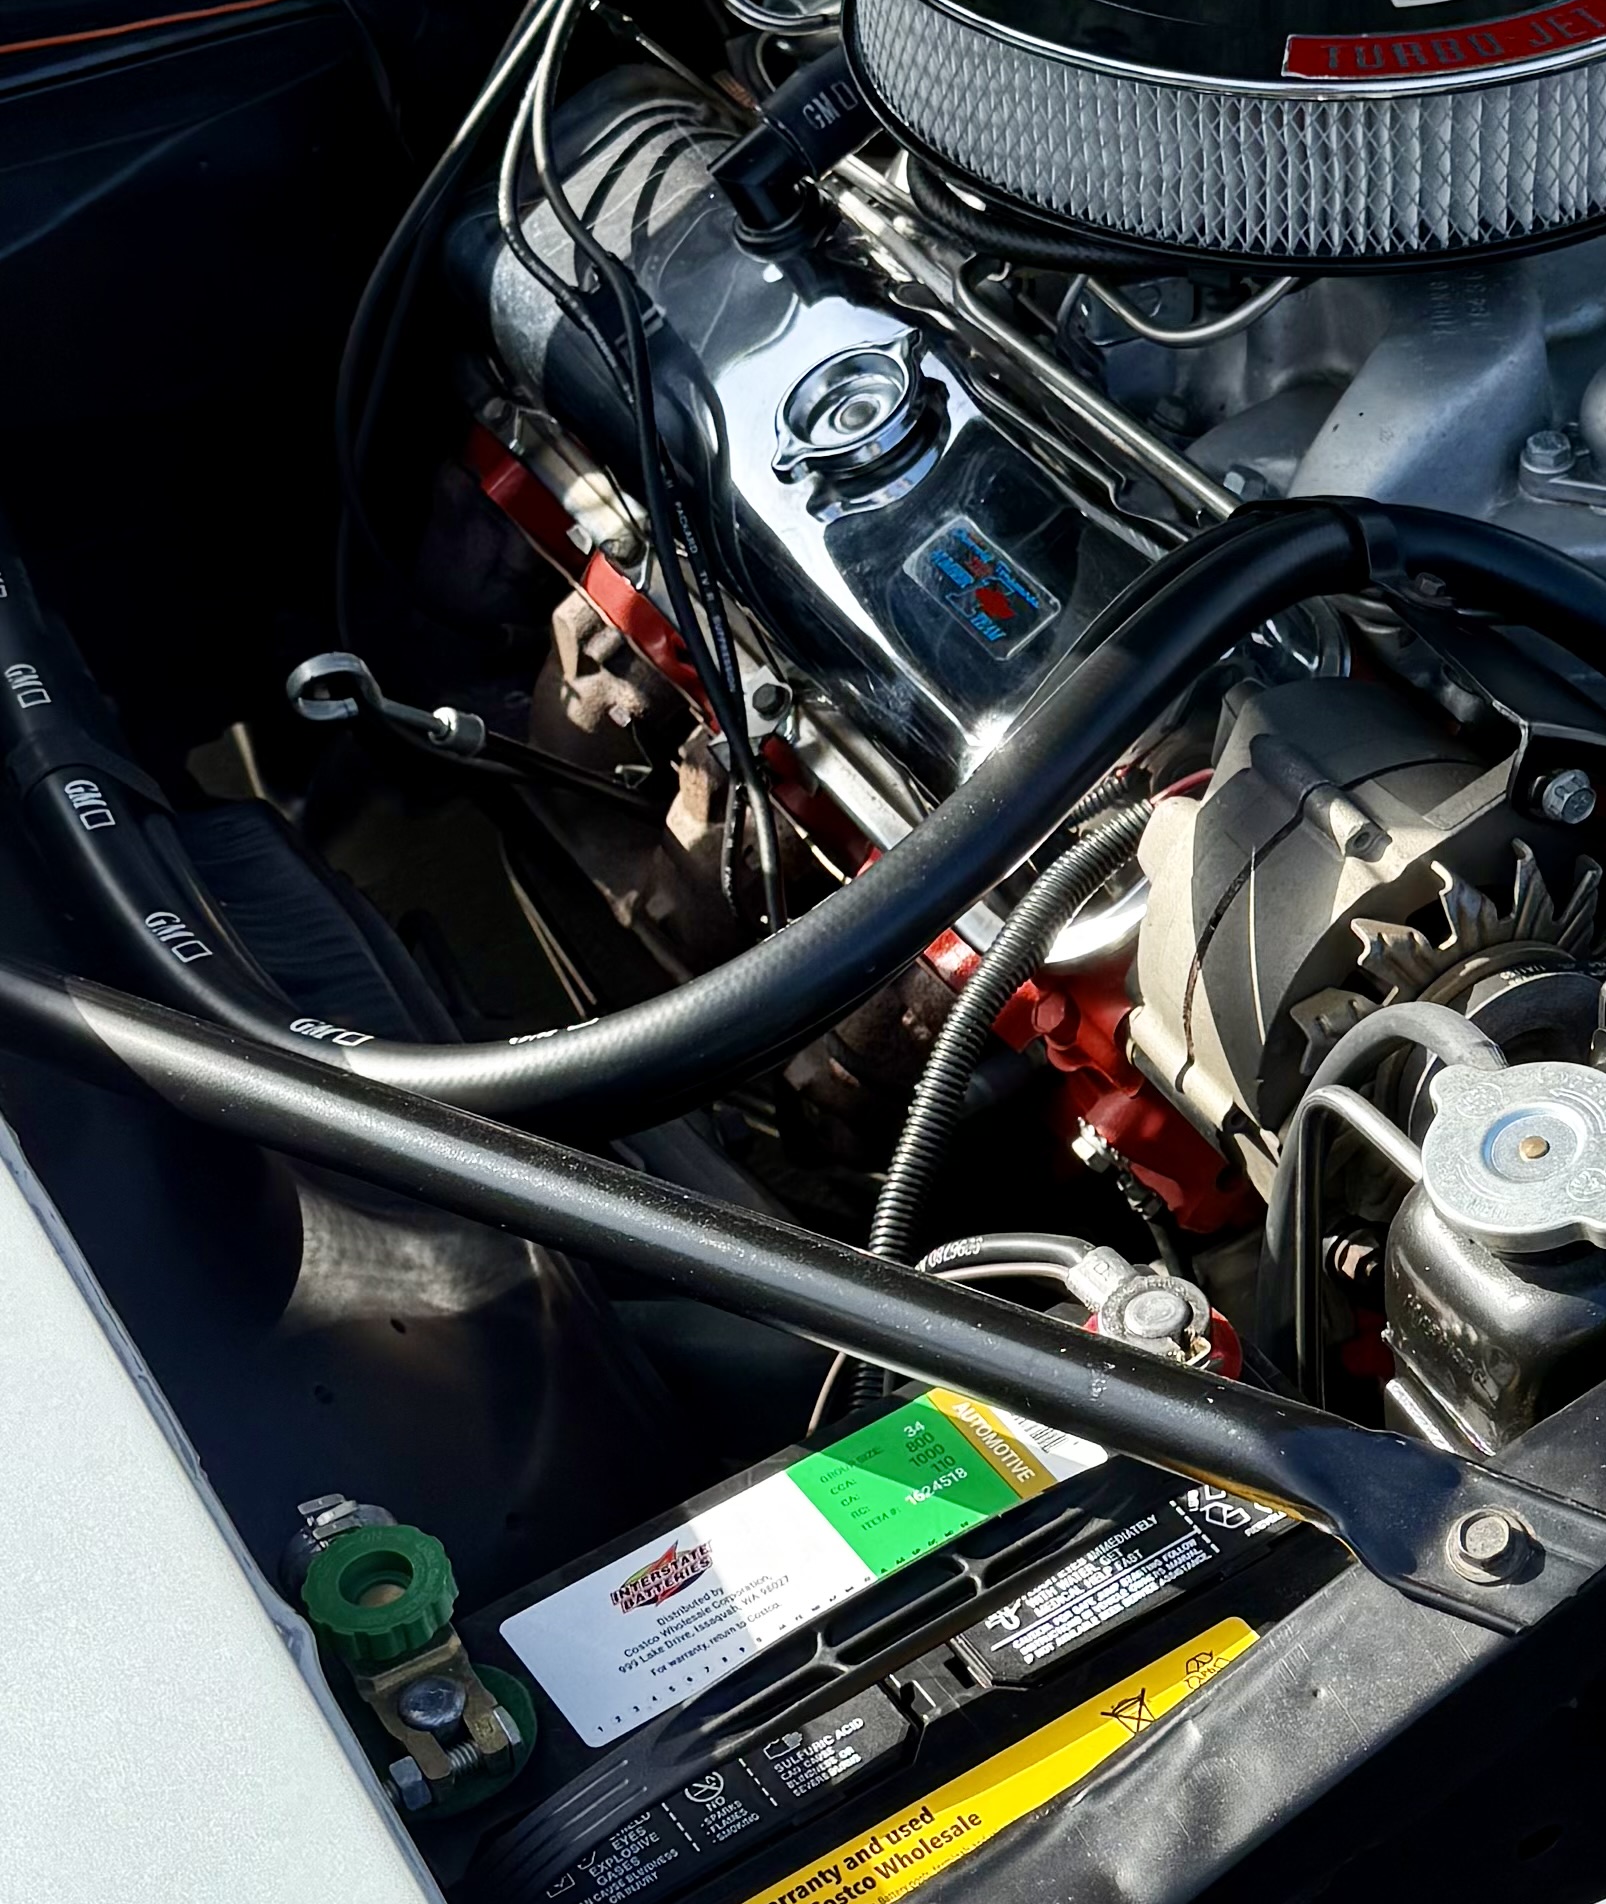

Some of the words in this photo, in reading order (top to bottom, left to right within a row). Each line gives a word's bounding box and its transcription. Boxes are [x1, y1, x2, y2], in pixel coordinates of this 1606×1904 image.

[1324, 31, 1502, 70] TURBO
[1527, 6, 1606, 48] JET
[803, 91, 841, 129] GM
[675, 501, 698, 555] PACKARD
[4, 663, 43, 691] GM
[64, 779, 107, 807] GM
[144, 911, 195, 942] GM
[289, 1018, 338, 1040] GM
[901, 1419, 927, 1438] 34
[904, 1430, 937, 1454] 800
[951, 1398, 1035, 1483] AUTOMOTIVE
[908, 1441, 947, 1469] 1000
[929, 1453, 958, 1474] 110
[903, 1464, 970, 1508] 1624518
[606, 1539, 717, 1605] INTERSTATE
[617, 1553, 716, 1613] BATTERIES
[655, 1592, 712, 1627] Distributed
[709, 1585, 726, 1598] by
[622, 1633, 661, 1658] Costco
[658, 1604, 713, 1638] Wholesale
[638, 1644, 665, 1663] Lake
[649, 1663, 667, 1676] For
[707, 1625, 737, 1645] return
[773, 1734, 835, 1773] SULFURIC
[832, 1716, 866, 1740] ACID
[703, 1798, 744, 1826] SPARKS
[705, 1794, 727, 1812] NO
[588, 1830, 661, 1879] EXPLOSIVE
[610, 1824, 647, 1852] EYES
[839, 1833, 885, 1871] and
[882, 1804, 935, 1846] used
[872, 1806, 983, 1882] Wholesale
[595, 1855, 641, 1888] GASES
[592, 1877, 626, 1903] CAUSE
